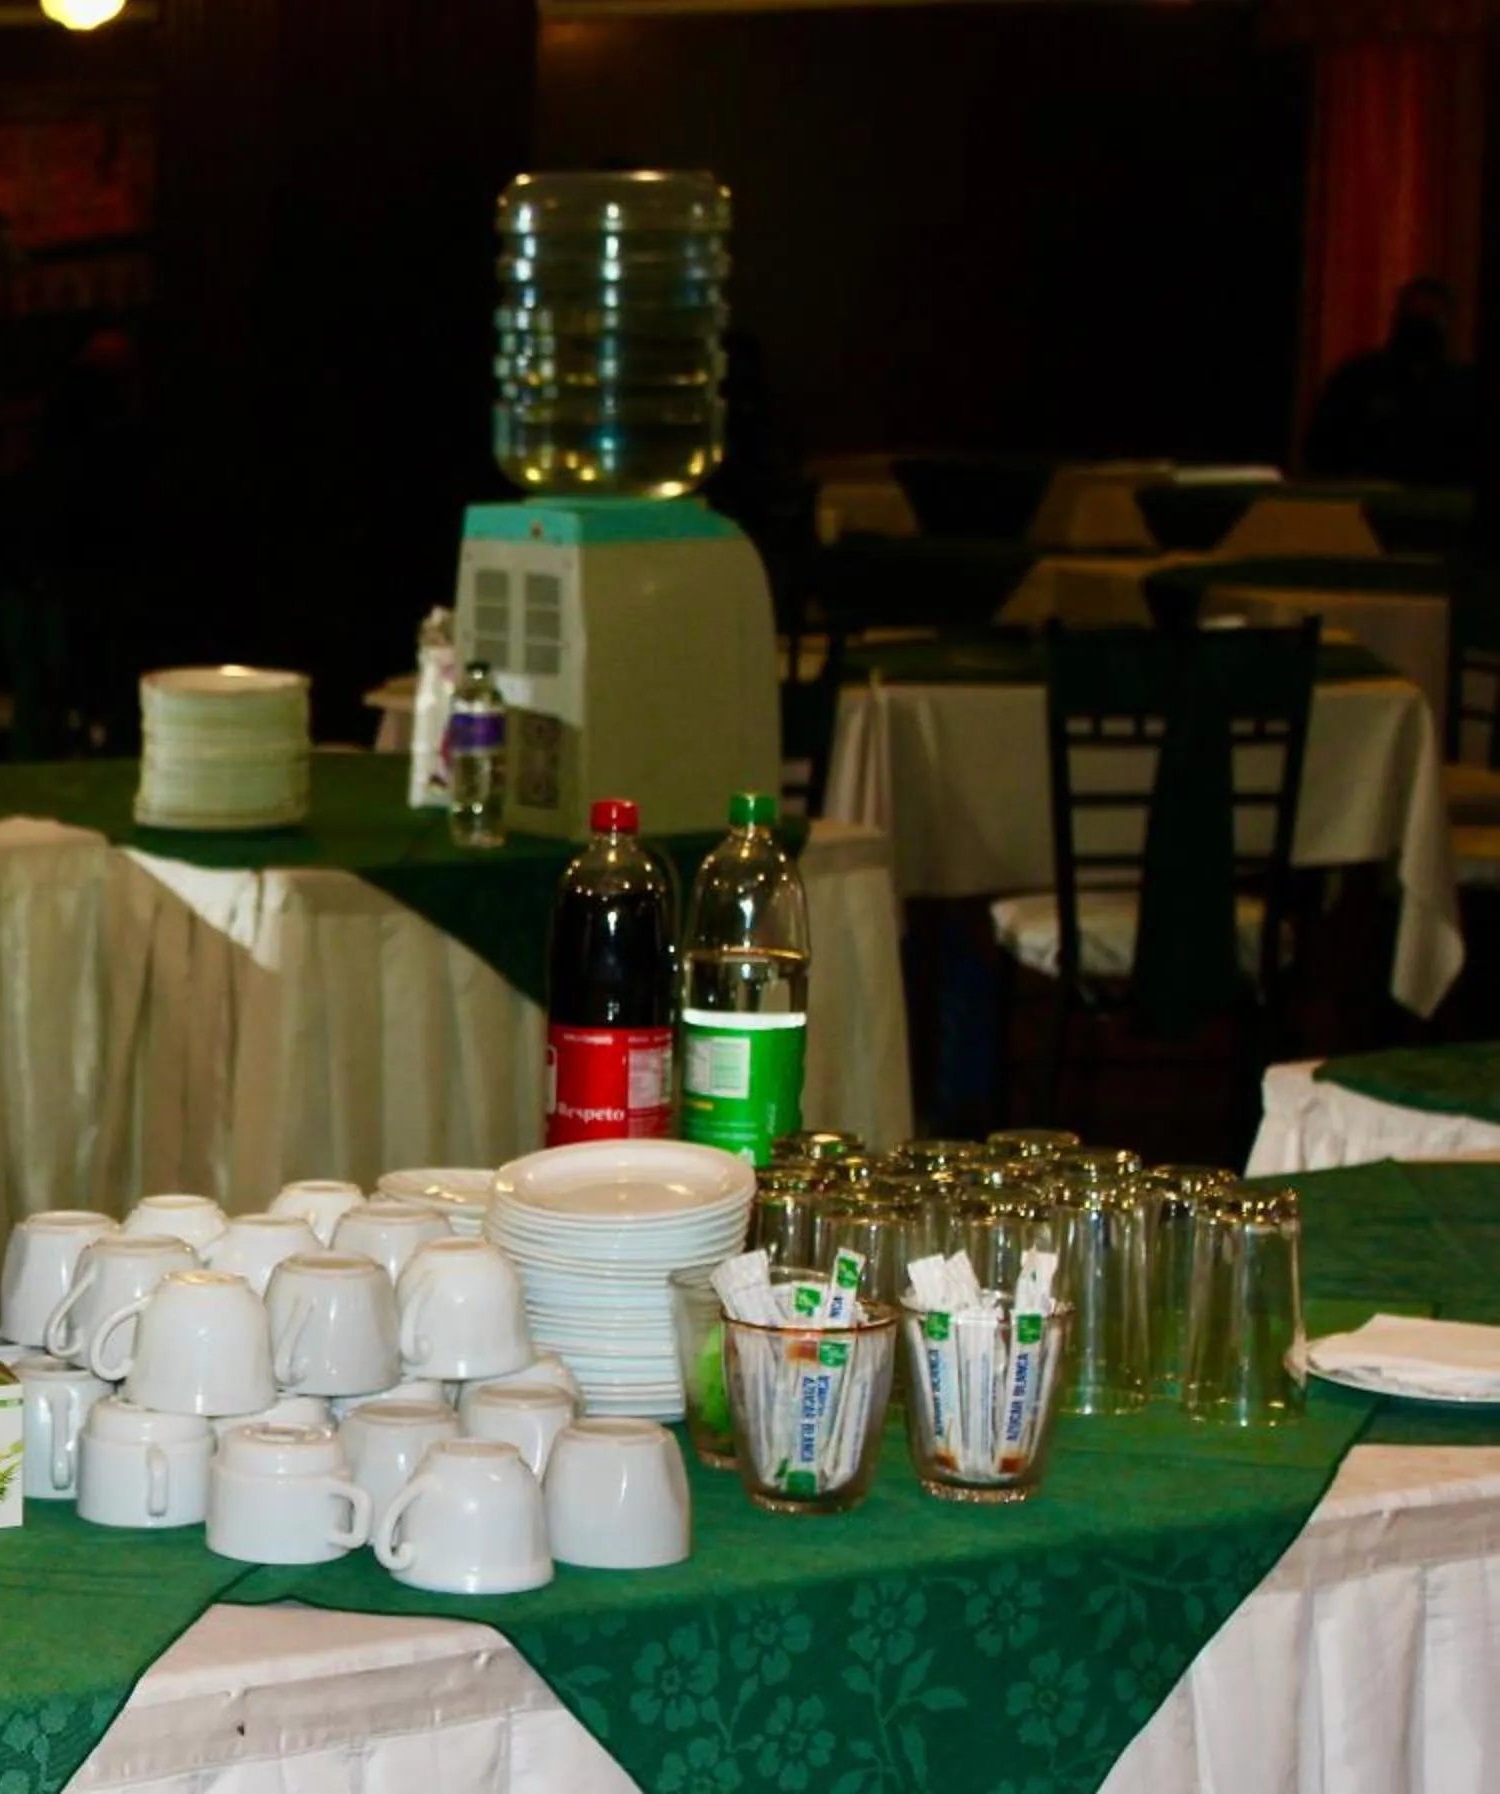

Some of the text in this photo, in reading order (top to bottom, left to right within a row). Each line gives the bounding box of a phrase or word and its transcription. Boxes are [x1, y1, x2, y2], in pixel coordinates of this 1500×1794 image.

[1012, 1353, 1029, 1397] BLANCA
[801, 1376, 815, 1463] AZUCAR BLANCA
